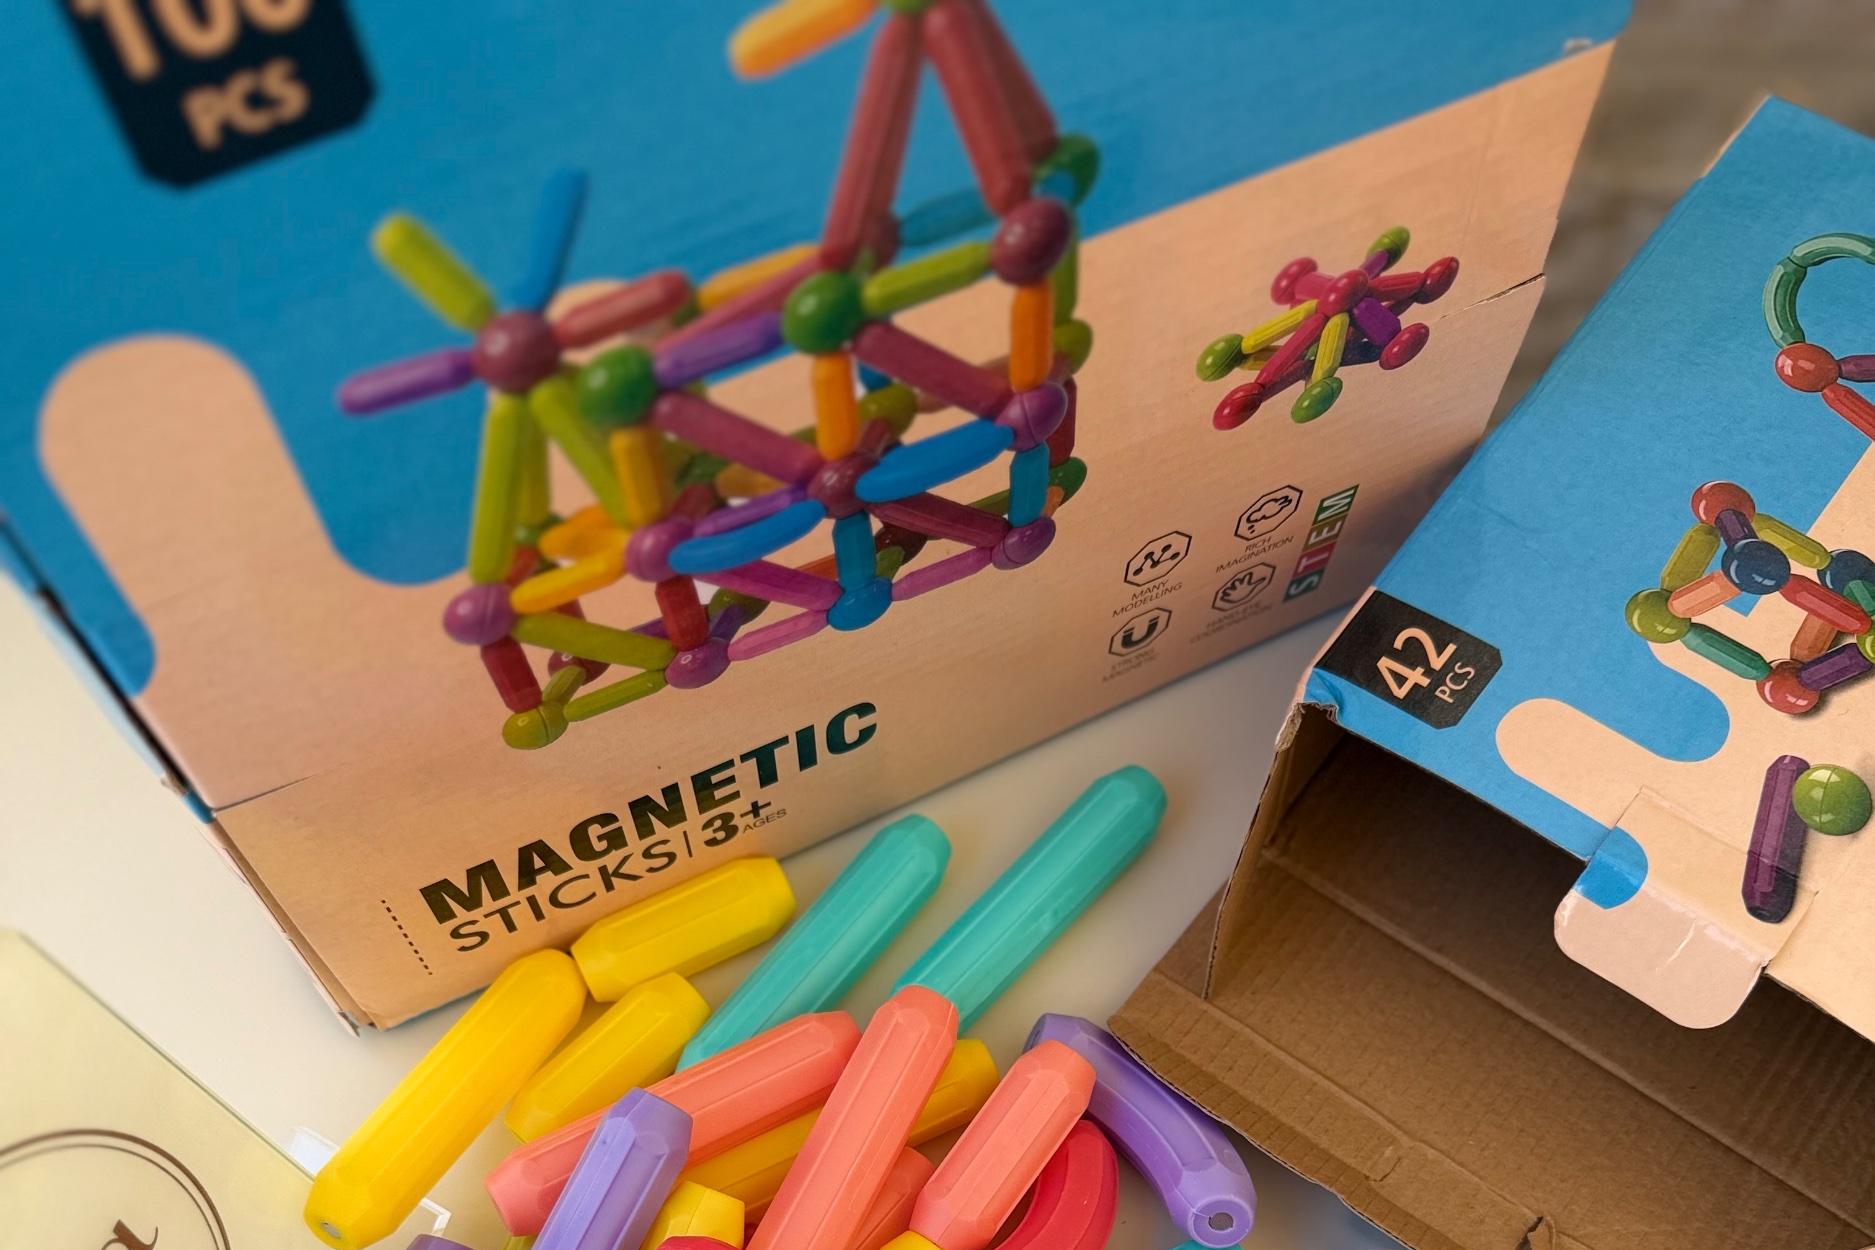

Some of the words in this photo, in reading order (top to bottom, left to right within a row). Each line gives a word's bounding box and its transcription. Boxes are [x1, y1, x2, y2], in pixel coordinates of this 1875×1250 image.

[183, 57, 311, 150] PCS
[1215, 535, 1294, 574] IMAGINATION
[1244, 536, 1272, 553] RICH
[1289, 490, 1354, 596] STEM
[1111, 581, 1183, 618] MODELLING
[1131, 579, 1169, 601] MANY
[1377, 627, 1457, 700] 42
[1434, 662, 1475, 703] PCS
[419, 702, 878, 925] MAGNETIC
[449, 838, 678, 953] STICKS
[742, 807, 788, 834] AGES
